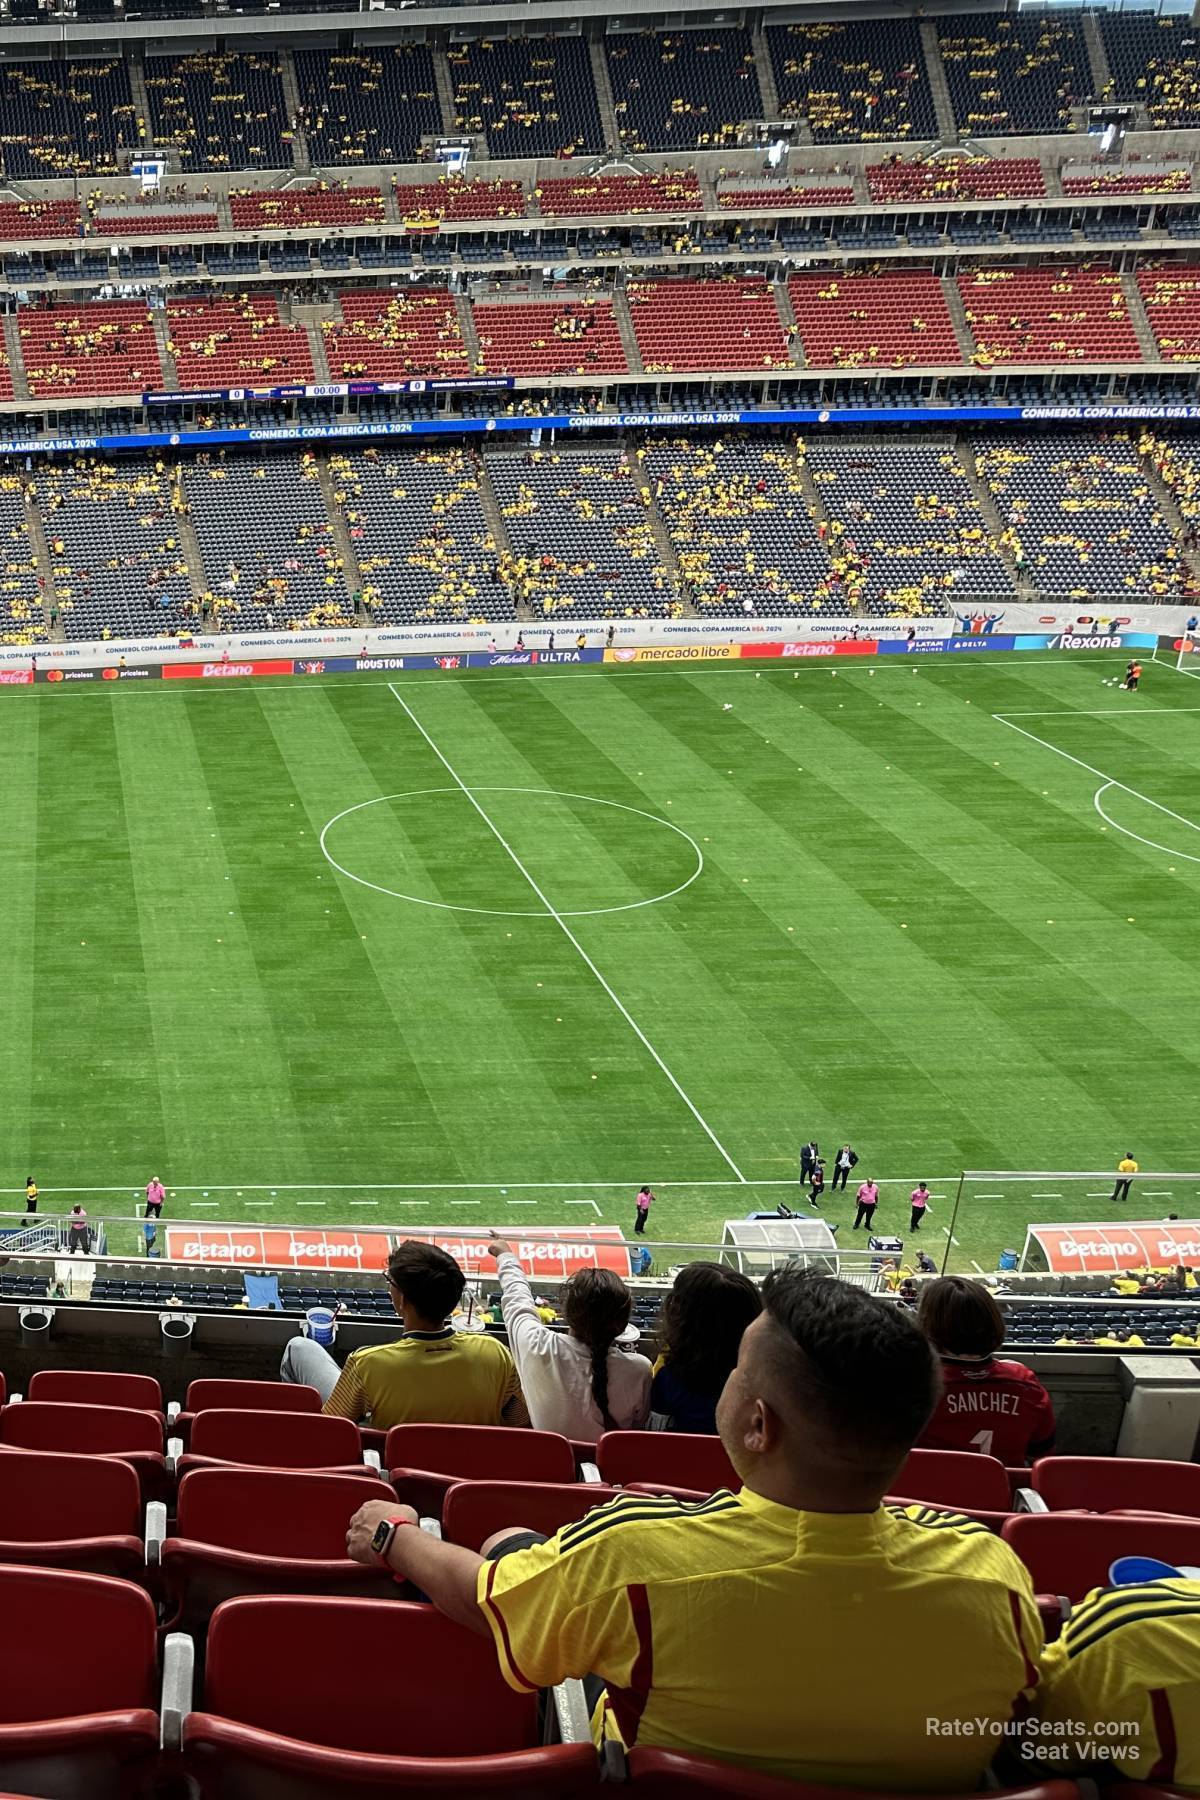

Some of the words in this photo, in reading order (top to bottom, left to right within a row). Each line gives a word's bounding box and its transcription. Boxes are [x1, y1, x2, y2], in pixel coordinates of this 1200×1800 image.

[313, 386, 340, 395] 00:00
[414, 382, 420, 390] 0
[234, 390, 240, 398] 0
[1021, 408, 1082, 418] CONMEBOL
[1083, 408, 1113, 418] COPA
[1113, 407, 1164, 418] AMERICA
[1166, 408, 1188, 418] USA
[569, 416, 623, 426] CONMEBOL
[623, 415, 650, 425] COPA
[650, 414, 695, 424] AMERICA
[696, 414, 715, 423] USA
[716, 413, 740, 422] 2024
[250, 429, 300, 439] CONMEBOL
[302, 427, 326, 437] COPA
[327, 425, 369, 436] AMERICA
[370, 425, 388, 433] USA
[389, 423, 412, 432] 2024
[15, 441, 55, 451] AMERICA
[56, 440, 74, 449] USA
[74, 438, 97, 448] 2024
[1059, 635, 1122, 649] Rexona
[641, 647, 699, 660] mercado
[701, 645, 730, 657] libre
[782, 643, 836, 656] Betano
[356, 658, 404, 670] HOUSTON
[490, 653, 530, 665] Michelob
[540, 651, 580, 662] ULTRA
[65, 672, 93, 680] priceless
[120, 669, 149, 678] priceless
[203, 664, 253, 677] Betano
[183, 1242, 256, 1258] Betano
[289, 1241, 364, 1257] Betano
[443, 1243, 490, 1258] tano
[518, 1243, 595, 1259] Betano
[1059, 1241, 1138, 1257] Betano
[946, 1391, 1020, 1416] SANCHEZ
